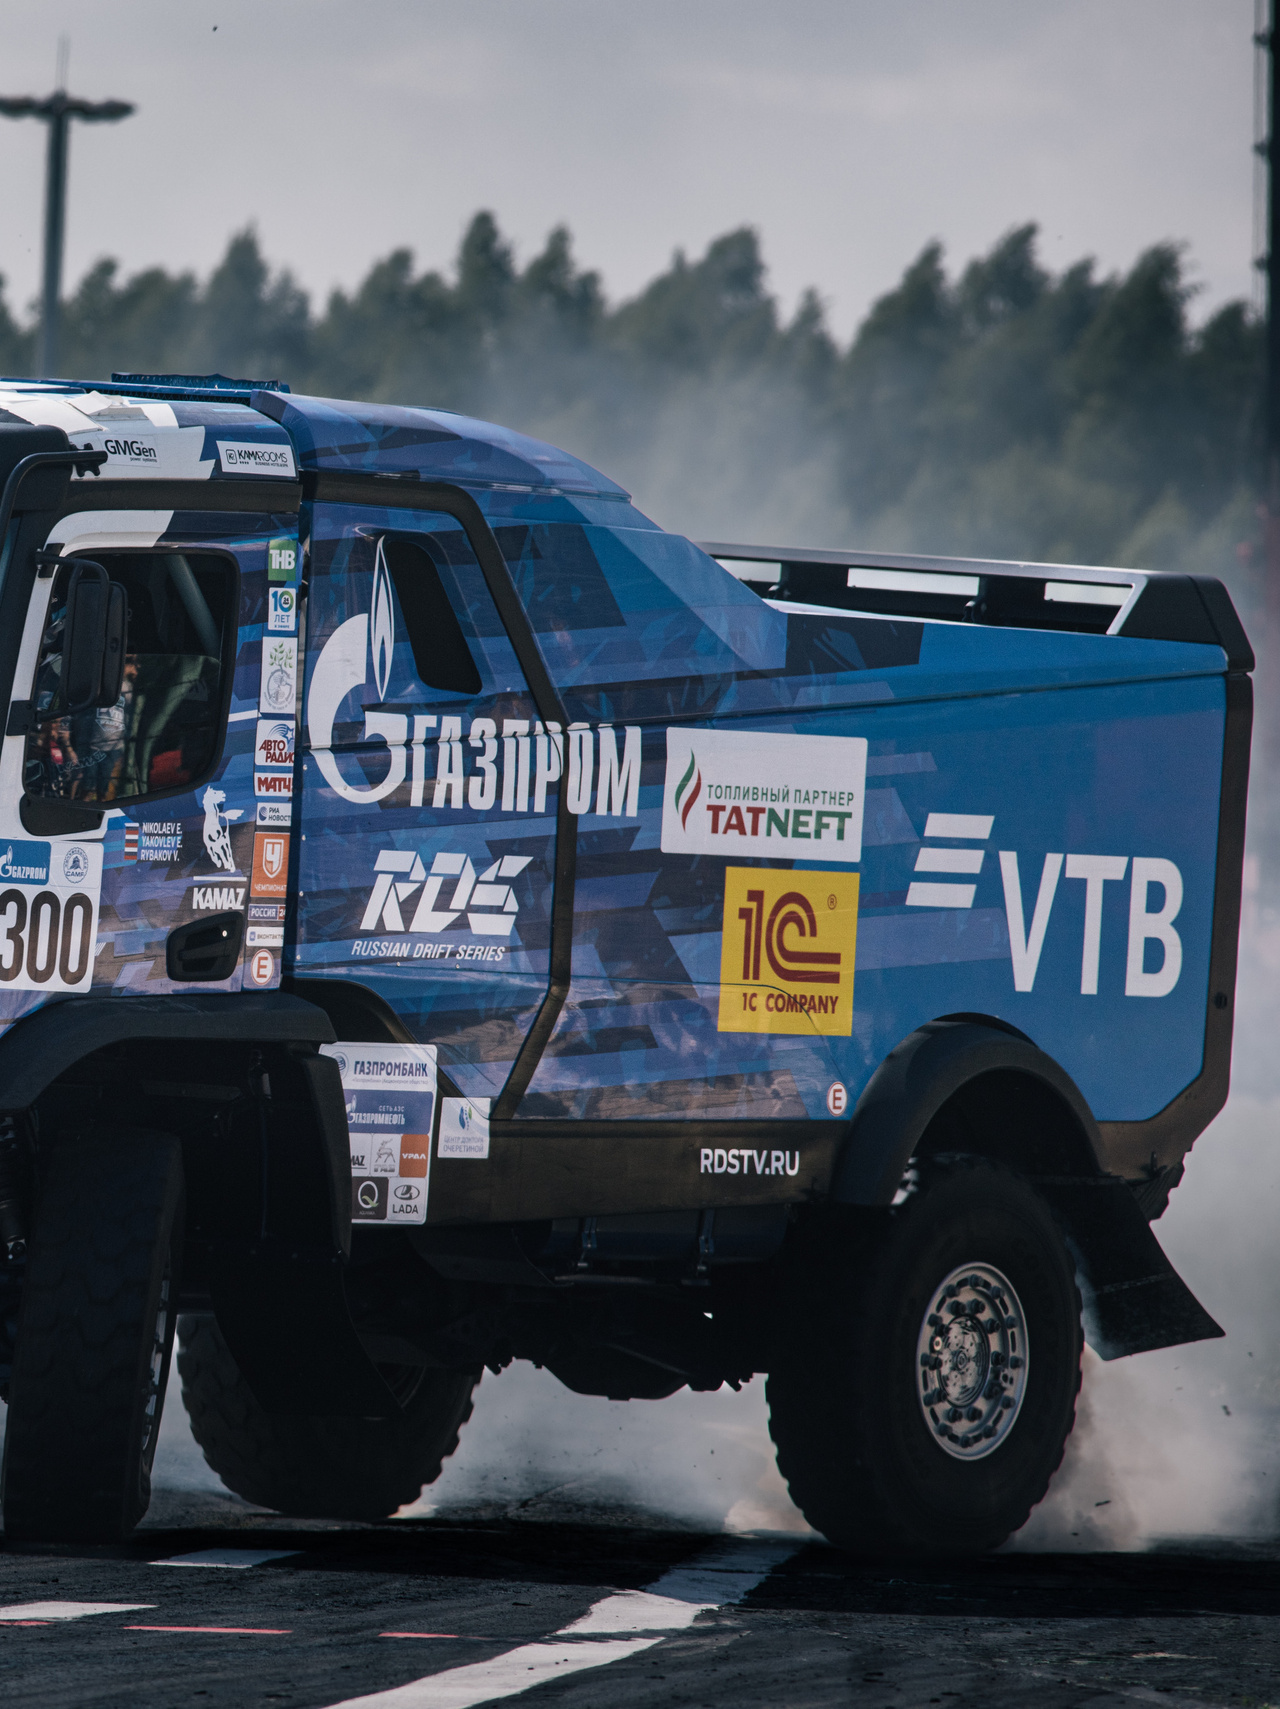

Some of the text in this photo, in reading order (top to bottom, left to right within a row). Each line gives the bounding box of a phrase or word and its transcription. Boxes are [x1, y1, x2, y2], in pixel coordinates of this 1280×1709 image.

[274, 614, 290, 623] ЛЕТ
[259, 739, 286, 752] АВТО
[410, 714, 641, 818] ГАЗПРОМ
[707, 783, 855, 807] ТОПЛИВНЫЙ ПАРТНЕР
[142, 822, 182, 834] NIKOLAEV E.
[706, 804, 853, 841] TATNEFT
[141, 835, 182, 848] YAKOVLEV E.
[140, 849, 180, 861] RYBAKOV V.
[12, 866, 47, 880] GAZPROM
[192, 887, 246, 910] KAMAZ
[360, 850, 534, 936] RDS
[251, 907, 276, 917] РОССИЯ
[999, 850, 1184, 998] VTB
[351, 940, 506, 962] RUSSIAN DRIFT SERIES
[742, 992, 839, 1014] 1C COMPANY
[354, 1060, 428, 1077] ГАЗПРОМБАНК
[354, 1112, 406, 1125] ГАЗПРОМНЕФТЬ
[443, 1143, 484, 1153] ОЧЕРЕТИНОЙ
[700, 1148, 800, 1176] RDSTV.RU
[392, 1204, 419, 1214] LADA
